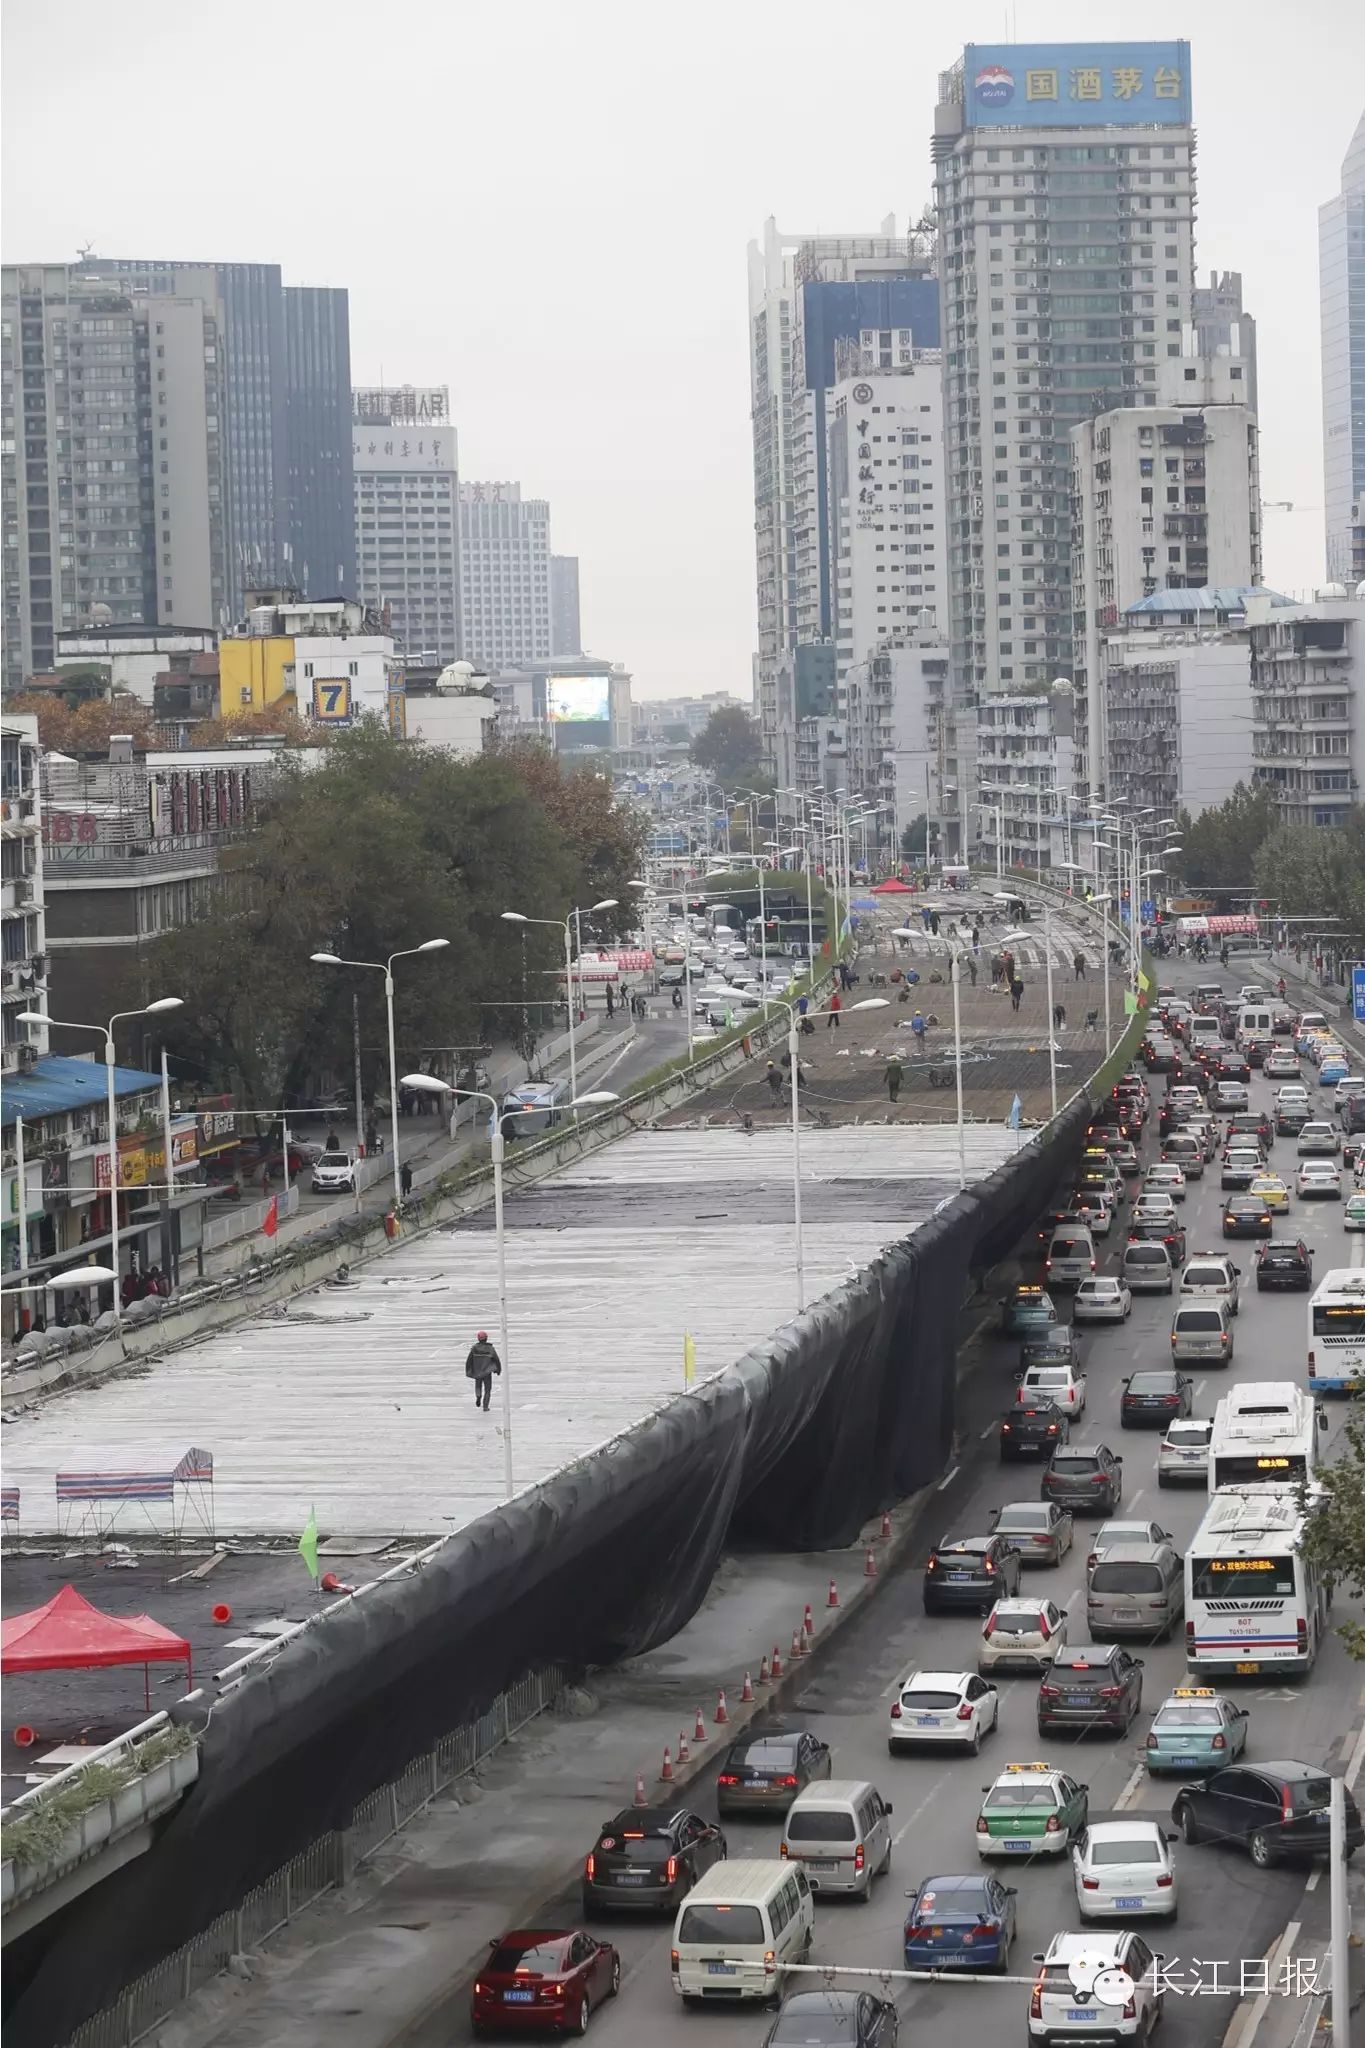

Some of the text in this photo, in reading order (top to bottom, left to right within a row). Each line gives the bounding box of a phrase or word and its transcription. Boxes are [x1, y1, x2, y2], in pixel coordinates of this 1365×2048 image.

[1026, 65, 1182, 102] 国酒茅台
[856, 418, 876, 505] 中国银行
[861, 515, 872, 523] OF
[320, 685, 343, 712] 7
